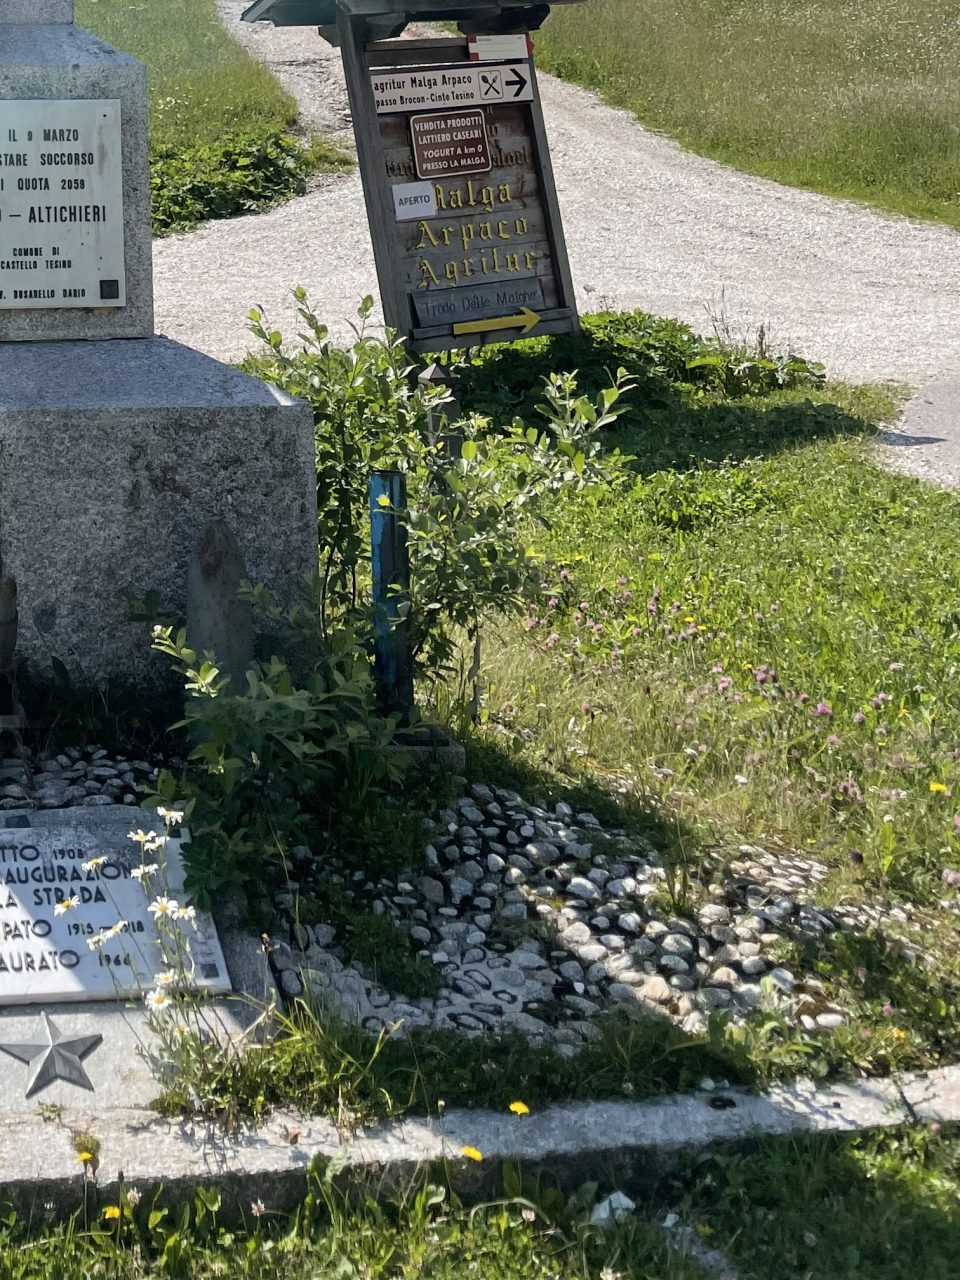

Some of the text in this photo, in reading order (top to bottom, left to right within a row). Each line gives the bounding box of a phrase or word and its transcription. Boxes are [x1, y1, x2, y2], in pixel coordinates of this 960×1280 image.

[373, 74, 472, 96] agritur Malga Arpaco
[376, 98, 397, 108] passo
[450, 90, 474, 101] Tesino
[414, 115, 482, 132] VENDITA PRODOTTI
[8, 129, 18, 142] IL
[28, 131, 33, 141] 9
[43, 129, 79, 142] MARZO
[418, 134, 451, 145] LATTIERO
[453, 130, 482, 140] CASEARI
[40, 152, 94, 166] SOCCORSO
[423, 147, 454, 159] YOGURT
[456, 146, 463, 155] A
[464, 146, 475, 154] km
[422, 159, 448, 170] PRESSO
[450, 159, 459, 167] LA
[461, 156, 485, 166] MALGA
[18, 178, 50, 191] QUOTA
[61, 178, 85, 190] 2059
[398, 195, 430, 206] APERTO
[29, 205, 106, 223] ALTICHIERI
[416, 217, 529, 251] Arpaco
[13, 247, 60, 256] COMUNE DI
[1, 260, 71, 270] CASTELLO TESINO
[14, 289, 55, 299] BUSARELLO
[63, 289, 85, 298] DARIO
[462, 295, 490, 311] Delle
[496, 290, 537, 305] Malghe
[53, 849, 84, 860] 1908
[33, 886, 106, 906] STRADA
[68, 923, 93, 936] 1915
[117, 921, 144, 933] 918
